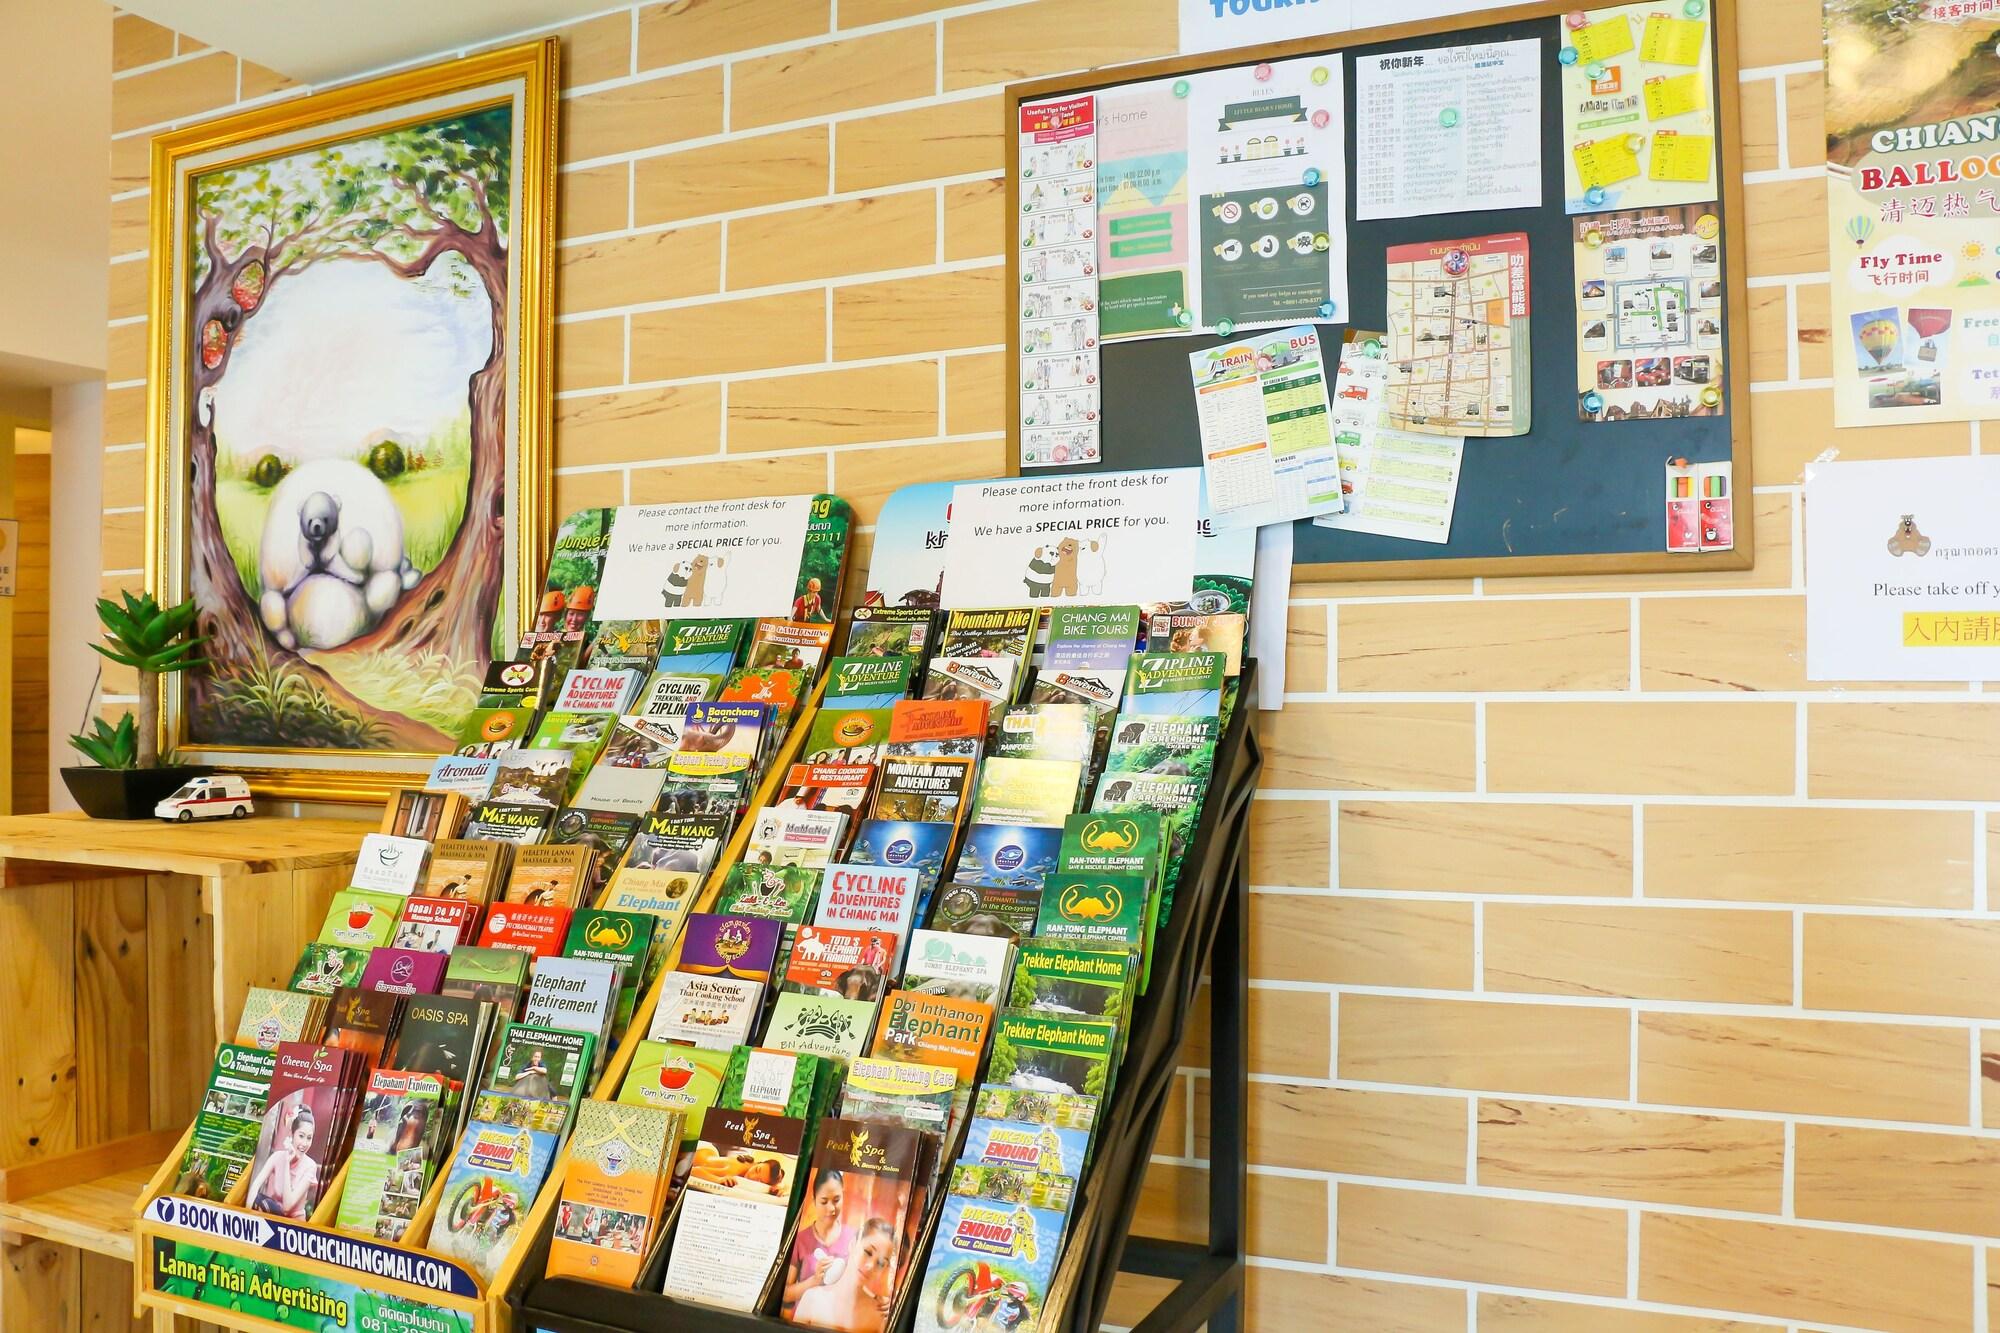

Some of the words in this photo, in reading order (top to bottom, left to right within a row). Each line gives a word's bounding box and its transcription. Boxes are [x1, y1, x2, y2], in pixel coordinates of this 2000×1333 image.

[1932, 0, 2000, 19] 接客时间
[1027, 108, 1046, 116] Useful
[1068, 101, 1088, 111] Visitors
[1112, 109, 1147, 123] Home
[1872, 116, 2000, 153] CHIAN
[1860, 256, 1889, 269] Fly
[1895, 252, 1943, 265] Time
[1868, 270, 1929, 285] 飞行时间
[1290, 335, 1316, 349] BUS
[1220, 353, 1253, 368] TRAIN
[982, 486, 1018, 498] Please
[1021, 482, 1063, 495] contact
[1066, 480, 1085, 493] the
[1088, 477, 1118, 491] front
[1121, 475, 1148, 488] desk
[1151, 474, 1169, 486] for
[638, 508, 666, 518] Please
[668, 505, 702, 516] contact
[704, 504, 719, 514] the
[721, 502, 746, 513] front
[748, 500, 769, 511] desk
[771, 500, 786, 509] for
[1018, 500, 1049, 513] more
[1052, 496, 1125, 511] information.
[665, 522, 689, 532] more
[691, 518, 748, 531] information.
[974, 525, 993, 537] We
[996, 523, 1023, 535] have
[1026, 525, 1032, 533] a
[1036, 519, 1083, 532] SPECIAL
[1086, 517, 1120, 530] PRICE
[1123, 515, 1142, 528] for
[1145, 515, 1169, 529] you.
[628, 543, 643, 553] We
[645, 541, 666, 552] have
[676, 539, 714, 550] SPECIAL
[716, 537, 743, 548] PRICE
[746, 535, 760, 546] for
[762, 536, 781, 547] you.
[1874, 583, 1922, 596] Please
[1927, 582, 1959, 596] take
[1965, 581, 1989, 595] off
[951, 612, 1004, 629] Mountain
[1004, 611, 1030, 628] Bike
[1061, 612, 1108, 624] CHIANG
[1110, 612, 1131, 622] MAI
[1063, 625, 1087, 635] BIKE
[1091, 625, 1129, 634] TOURS
[947, 642, 977, 657] Downhill
[964, 646, 982, 657] Trips
[845, 671, 900, 682] ADVENTURE
[1146, 667, 1213, 679] ADVENTURE
[571, 675, 625, 689] CYCLING
[657, 683, 702, 696] CYCLING,
[567, 690, 618, 699] ADVENTURES
[708, 707, 759, 717] Baanchang
[1148, 723, 1209, 735] ELEPHANT
[437, 763, 491, 778] Aromdii
[887, 763, 933, 776] MOUNTAIN
[934, 765, 963, 777] BIKING
[895, 776, 950, 789] ADVENTURES
[1135, 780, 1198, 794] ELEPHANT
[479, 806, 505, 823] MAE
[508, 814, 539, 826] WANG
[649, 817, 679, 835] MAE
[681, 825, 715, 837] WANG
[1069, 857, 1106, 865] RAN-TONG
[1108, 857, 1144, 865] ELEPHANT
[832, 871, 906, 896] CYCLING
[617, 894, 681, 911] Elephant
[829, 892, 900, 909] ADVENTURES
[827, 908, 837, 918] IN
[839, 907, 877, 920] CHIANG
[879, 911, 899, 923] MAI
[1046, 924, 1085, 933] RAN-TONG
[1088, 926, 1128, 935] ELEPHANT
[1022, 952, 1052, 969] Trekker
[1054, 954, 1095, 974] Elephant
[1096, 958, 1122, 976] Home
[533, 974, 586, 994] Elephant
[687, 980, 708, 991] Asia
[710, 982, 741, 994] Scenic
[530, 993, 598, 1014] Retirement
[696, 991, 722, 1000] Cooking
[411, 1008, 444, 1022] OASIS
[447, 1012, 469, 1026] SPA
[526, 1012, 553, 1027] Park
[893, 998, 916, 1010] Doi
[921, 1001, 984, 1024] Inthanon
[888, 1011, 981, 1043] Elephant
[1003, 1022, 1036, 1040] Trekker
[1036, 1024, 1078, 1044] Elephant
[1078, 1028, 1105, 1047] Home
[510, 1029, 526, 1038] THAI
[527, 1031, 562, 1044] ELEPHANT
[563, 1035, 584, 1046] HOME
[884, 1028, 916, 1045] Park
[781, 1041, 796, 1049] BN
[799, 1040, 852, 1057] Adventure
[281, 1055, 309, 1069] Cheeva
[314, 1063, 333, 1072] Spa
[640, 1087, 657, 1097] Tom
[658, 1091, 677, 1100] Yum
[680, 1093, 697, 1103] Thai
[724, 1121, 744, 1131] Peak
[753, 1130, 771, 1140] Spa
[769, 1137, 776, 1145] &
[990, 1128, 1035, 1146] BIKERS
[473, 1141, 514, 1160] ENDURO
[826, 1140, 850, 1152] Peak
[863, 1145, 885, 1156] Spa
[985, 1142, 1039, 1161] ENDURO
[180, 1203, 219, 1233] BOOK
[222, 1213, 259, 1243] NOW!
[961, 1205, 1008, 1225] BIKERS
[956, 1221, 1012, 1243] ENDURO
[277, 1226, 452, 1292] TOUCHCHIANGMAI.COM
[159, 1251, 207, 1283] Lanna
[210, 1263, 245, 1293] Thai
[249, 1274, 348, 1327] Advertising
